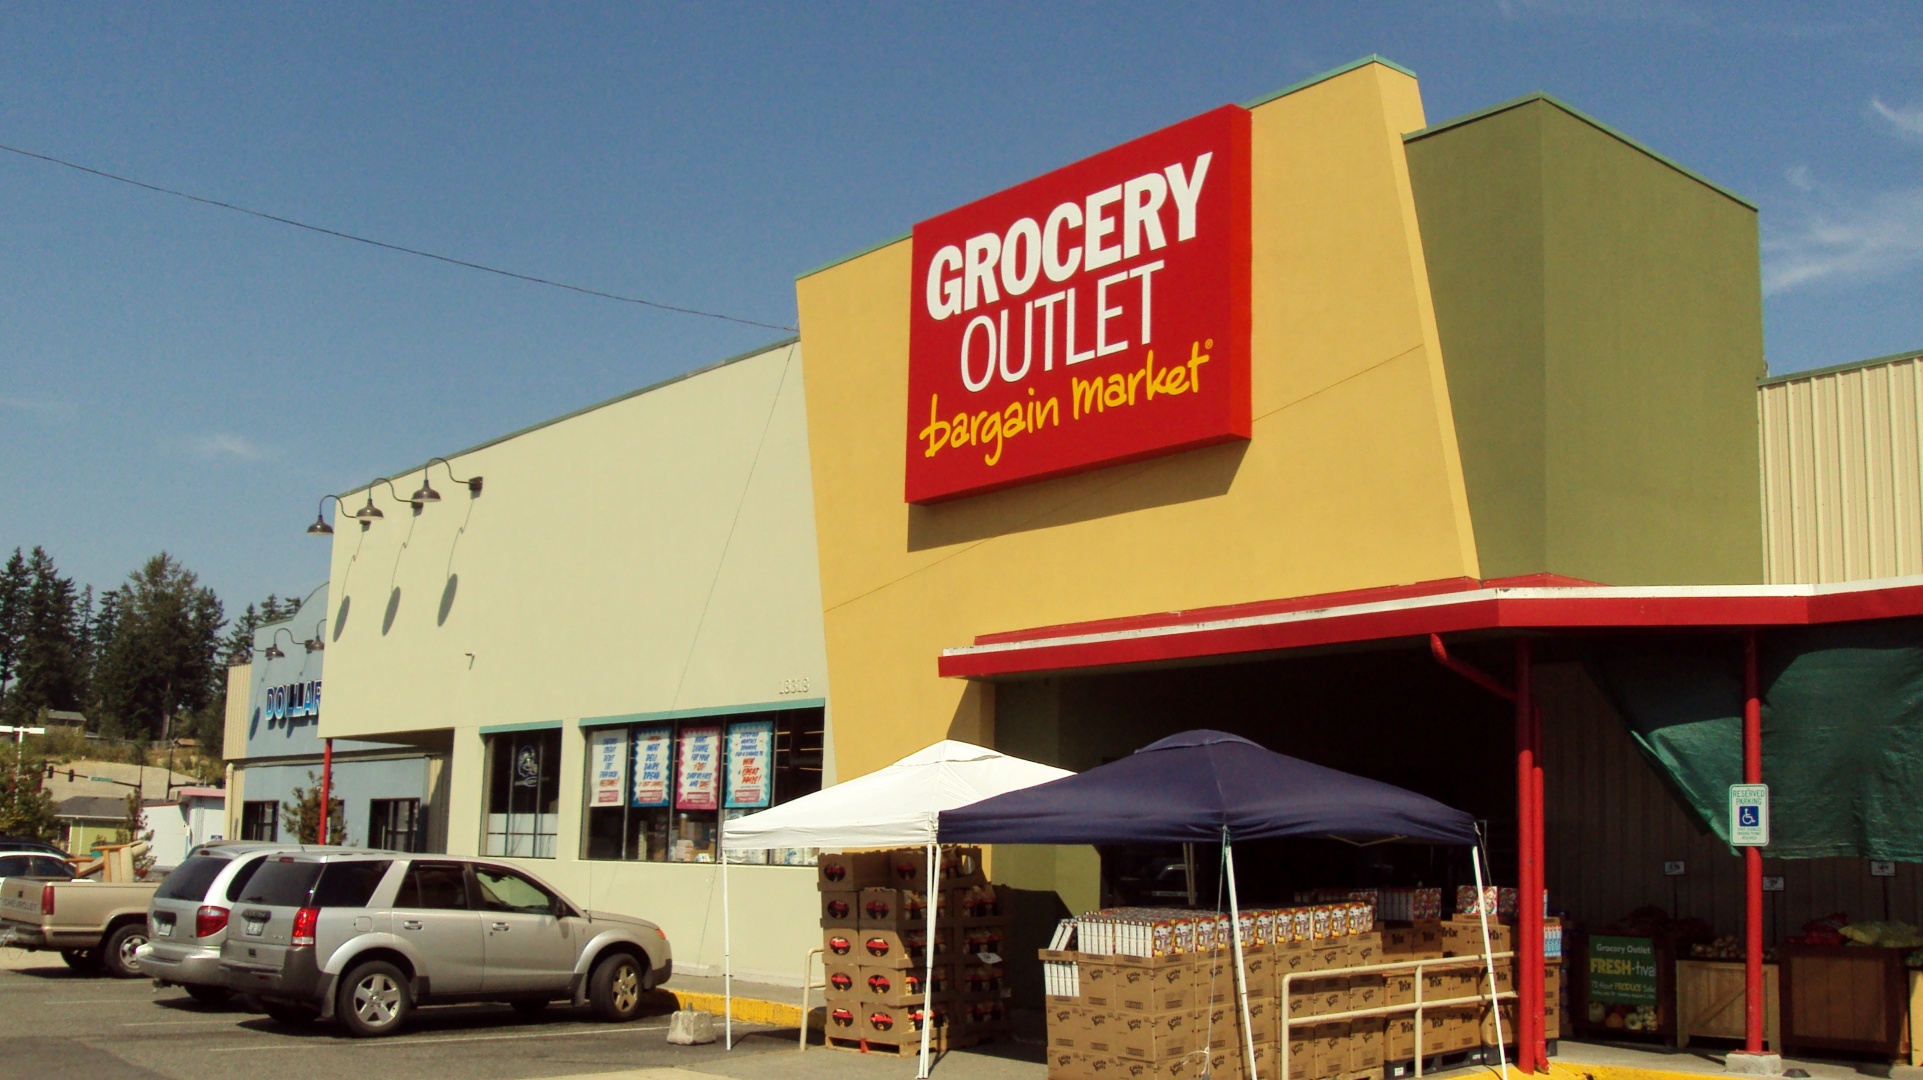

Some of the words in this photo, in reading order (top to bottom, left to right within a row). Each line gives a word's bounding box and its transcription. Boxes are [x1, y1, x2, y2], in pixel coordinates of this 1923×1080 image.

[926, 151, 1213, 321] GROCERY
[960, 260, 1165, 392] OUTLET
[919, 388, 1059, 466] bargain
[1071, 341, 1210, 420] market
[265, 680, 322, 720] DOLLAR
[1596, 943, 1626, 954] Grocery
[1627, 945, 1651, 954] Outlet
[1614, 982, 1642, 992] PRODUCE
